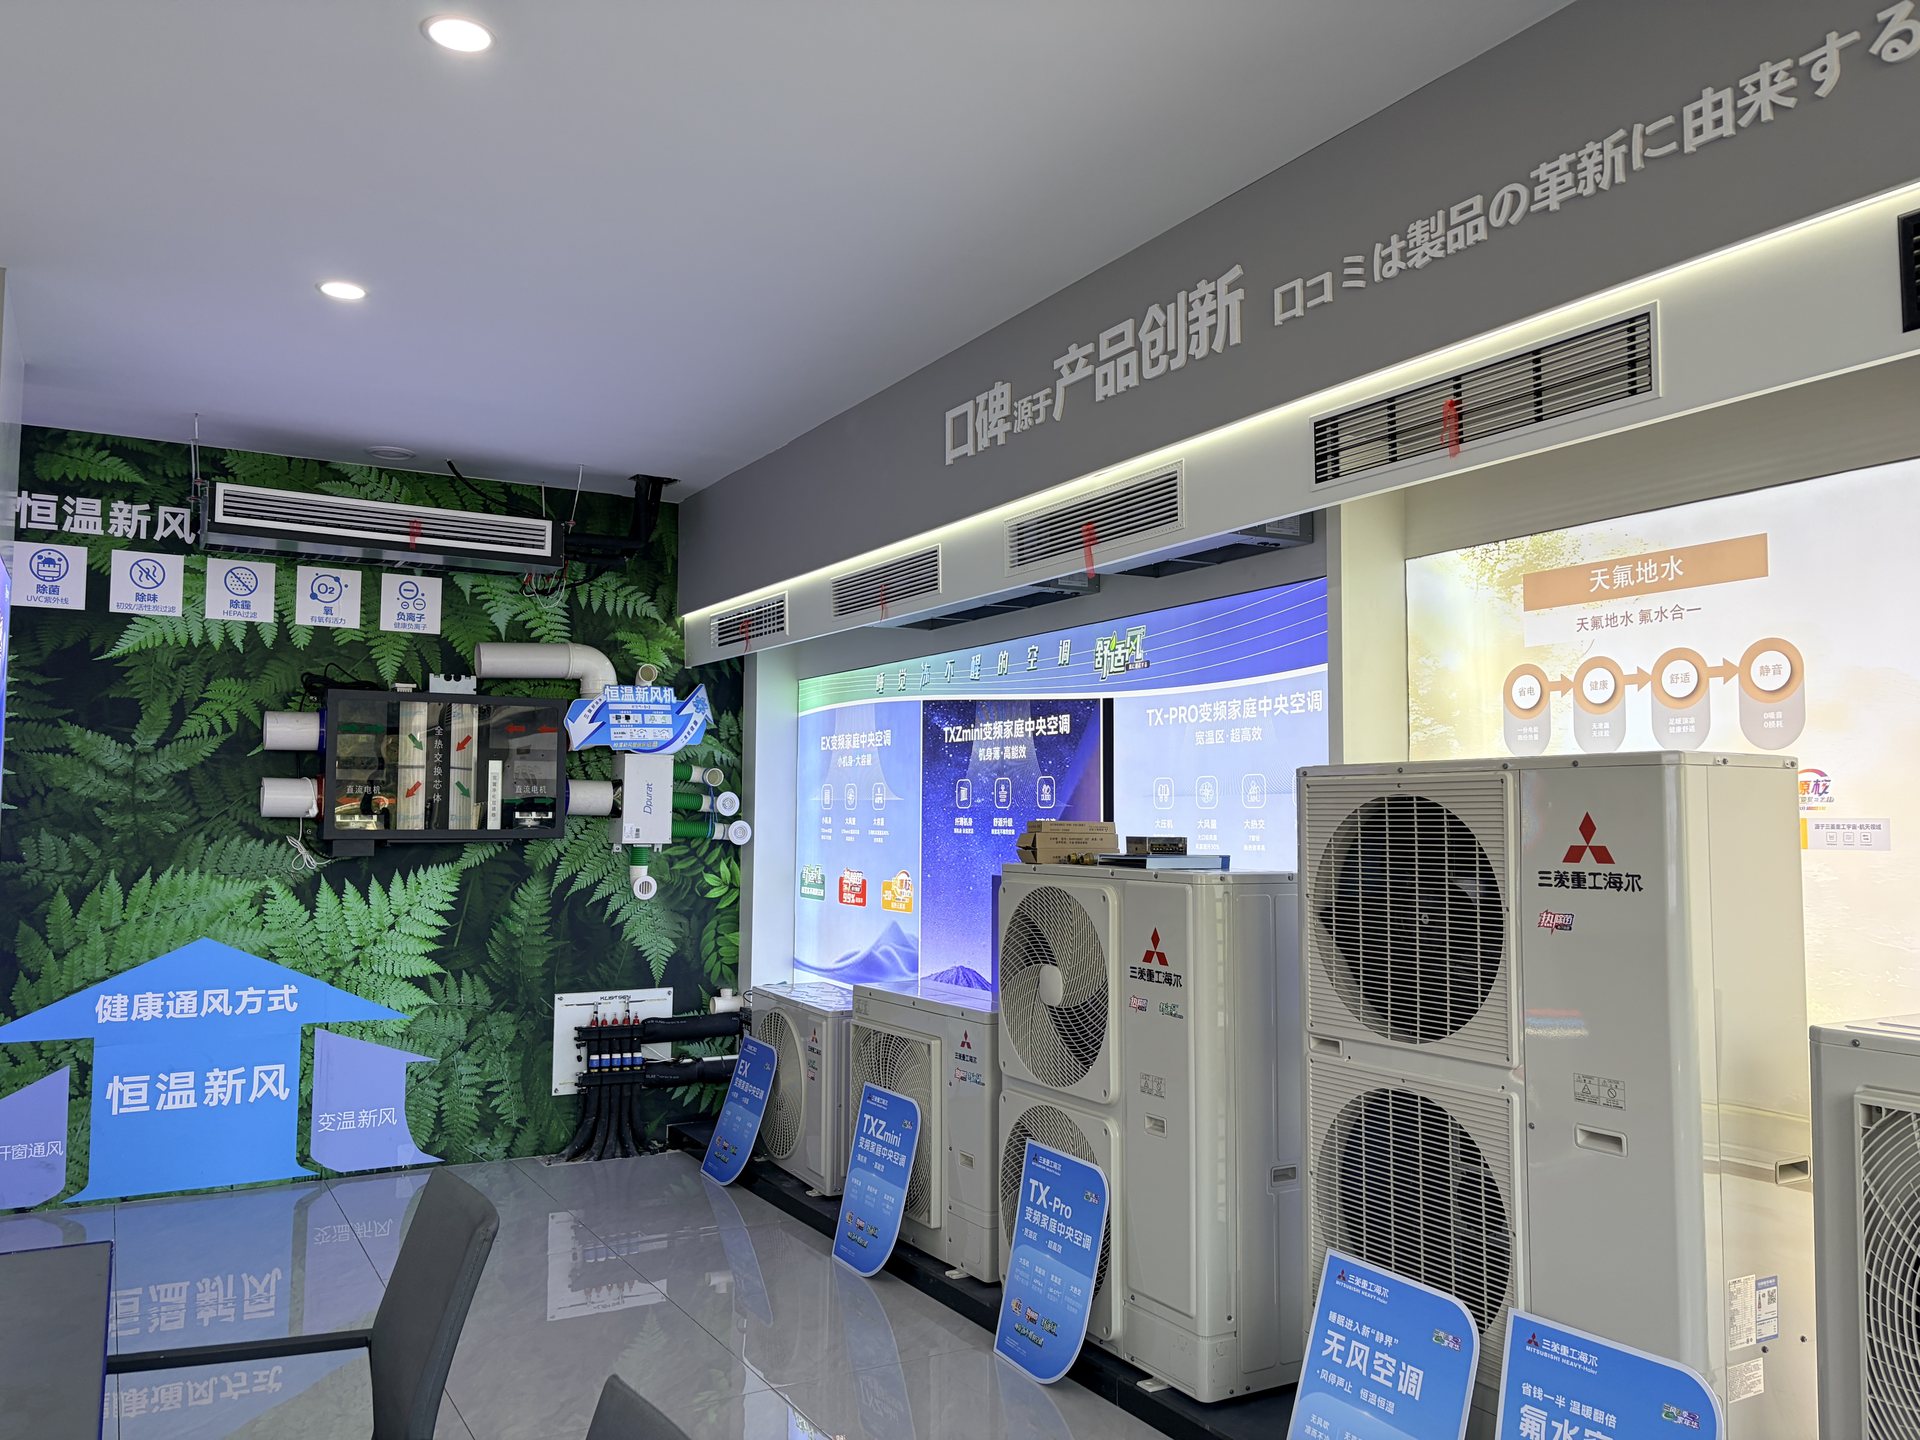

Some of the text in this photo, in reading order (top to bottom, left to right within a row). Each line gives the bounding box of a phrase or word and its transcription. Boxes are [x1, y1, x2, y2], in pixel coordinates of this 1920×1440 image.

[945, 263, 1245, 466] 口碑源于产品创新
[16, 490, 200, 545] 恒温新风
[1589, 555, 1684, 593] 天氟地水
[26, 594, 69, 605] UVC紫外线
[36, 584, 60, 596] 除菌
[135, 592, 158, 603] 除味
[116, 602, 176, 614] 初效/活性炭过滤
[222, 609, 258, 619] HEPA过滤
[230, 599, 251, 610] 除霾
[323, 605, 334, 616] 氧
[310, 615, 346, 625] 有氧有活力
[393, 622, 428, 631] 健康负离子
[396, 611, 426, 622] 负离子
[1576, 604, 1702, 633] 天氟地水 氟水合一
[1669, 672, 1691, 685] 舒适
[1759, 663, 1784, 677] 静音
[604, 685, 677, 704] 恒温新风机
[1517, 687, 1535, 697] 省电
[1589, 680, 1609, 692] 健康
[1146, 689, 1323, 727] TX-PRO变频家庭中央空调
[942, 714, 1071, 743] TXZmini变频家庭中央空调
[820, 729, 892, 751] EX变频家庭中央空调
[432, 725, 444, 804] 全热交换芯体
[346, 785, 381, 795] 直流电机
[515, 784, 547, 795] 直流电机
[1537, 869, 1644, 893] 三菱重工海尔
[1129, 965, 1183, 988] 三菱重工海尔
[95, 983, 299, 1024] 健康通风方式
[737, 1058, 751, 1078] EX
[105, 1063, 291, 1116] 恒温新风
[317, 1106, 398, 1133] 变温新风
[863, 1113, 902, 1148] TXZmini
[1029, 1177, 1072, 1219] TX-Pro
[1024, 1205, 1093, 1251] 变频家庭中央空调
[1347, 1274, 1390, 1298] 三菱重工海尔
[1525, 1345, 1561, 1364] MITSUBISHI
[1541, 1338, 1599, 1368] 三菱重工海尔
[1321, 1329, 1425, 1401] 无风空调
[1521, 1382, 1617, 1430] 省钱一半 温暖翻倍
